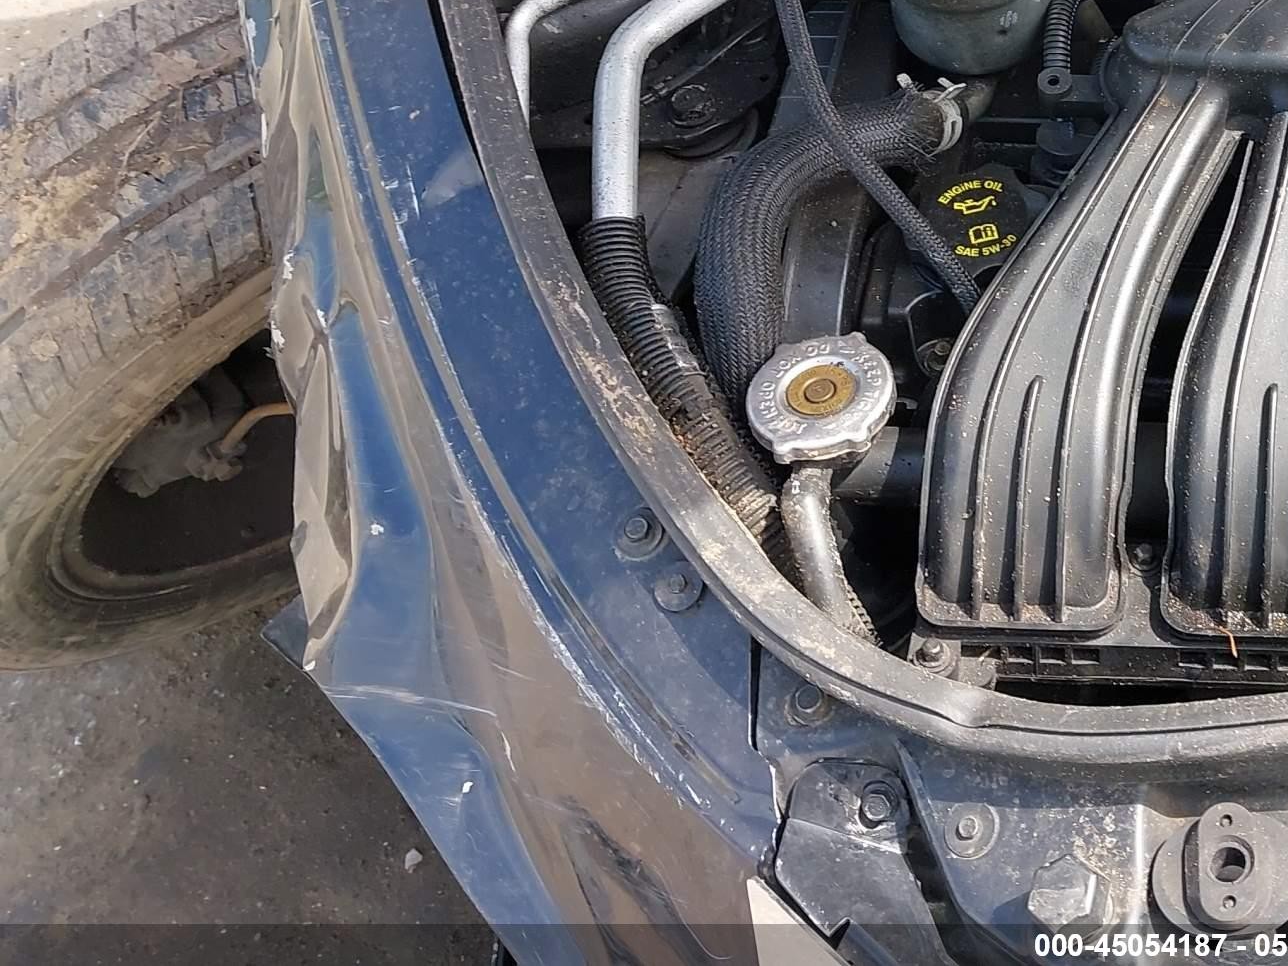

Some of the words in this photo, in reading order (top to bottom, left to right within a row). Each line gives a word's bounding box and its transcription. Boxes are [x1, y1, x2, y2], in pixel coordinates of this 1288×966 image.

[937, 180, 982, 205] ENGINE
[983, 180, 1004, 193] OIL
[955, 245, 980, 257] SAE
[982, 234, 1017, 256] 5W-30
[805, 343, 830, 357] DO
[776, 354, 803, 378] NOT
[758, 381, 778, 419] OPEN
